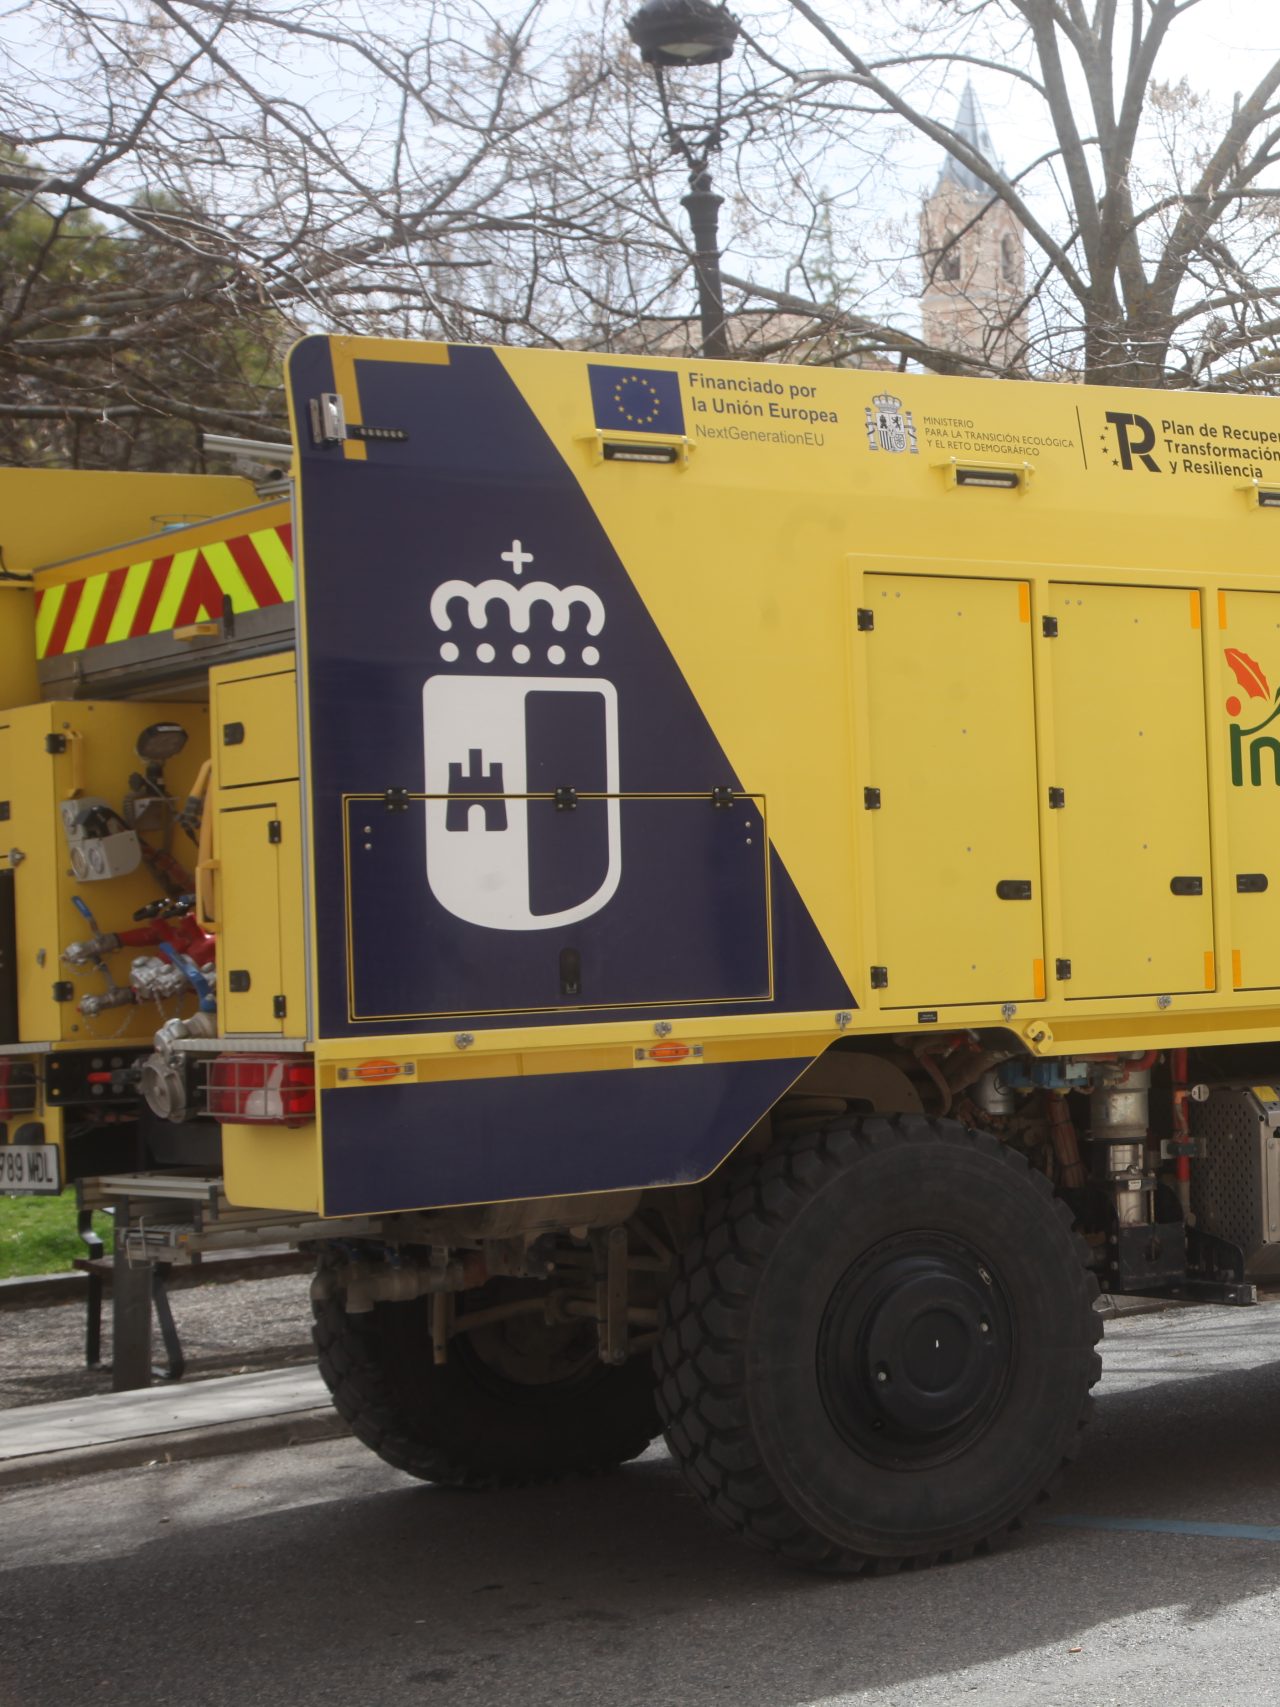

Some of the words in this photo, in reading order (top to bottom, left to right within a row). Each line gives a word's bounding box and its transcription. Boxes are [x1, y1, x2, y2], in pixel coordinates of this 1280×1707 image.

[688, 372, 784, 395] Financiado
[789, 384, 817, 400] por
[691, 396, 707, 412] la
[712, 398, 764, 417] Unión
[768, 402, 838, 424] Europea
[923, 416, 974, 429] MINISTERIO
[1161, 420, 1195, 436] Plan
[1199, 423, 1218, 438] de
[695, 424, 825, 447] NextGenerationEU
[925, 427, 948, 437] PARA
[951, 430, 962, 438] LA
[965, 430, 1020, 444] TRANSICIÓN
[1022, 435, 1075, 448] ECOLÓGICA
[927, 439, 933, 447] Y
[936, 440, 945, 449] EL
[948, 440, 971, 451] RETO
[974, 442, 1040, 456] DEMOGRÁFICO
[1169, 461, 1178, 474] y
[1183, 459, 1263, 479] Resiliencia
